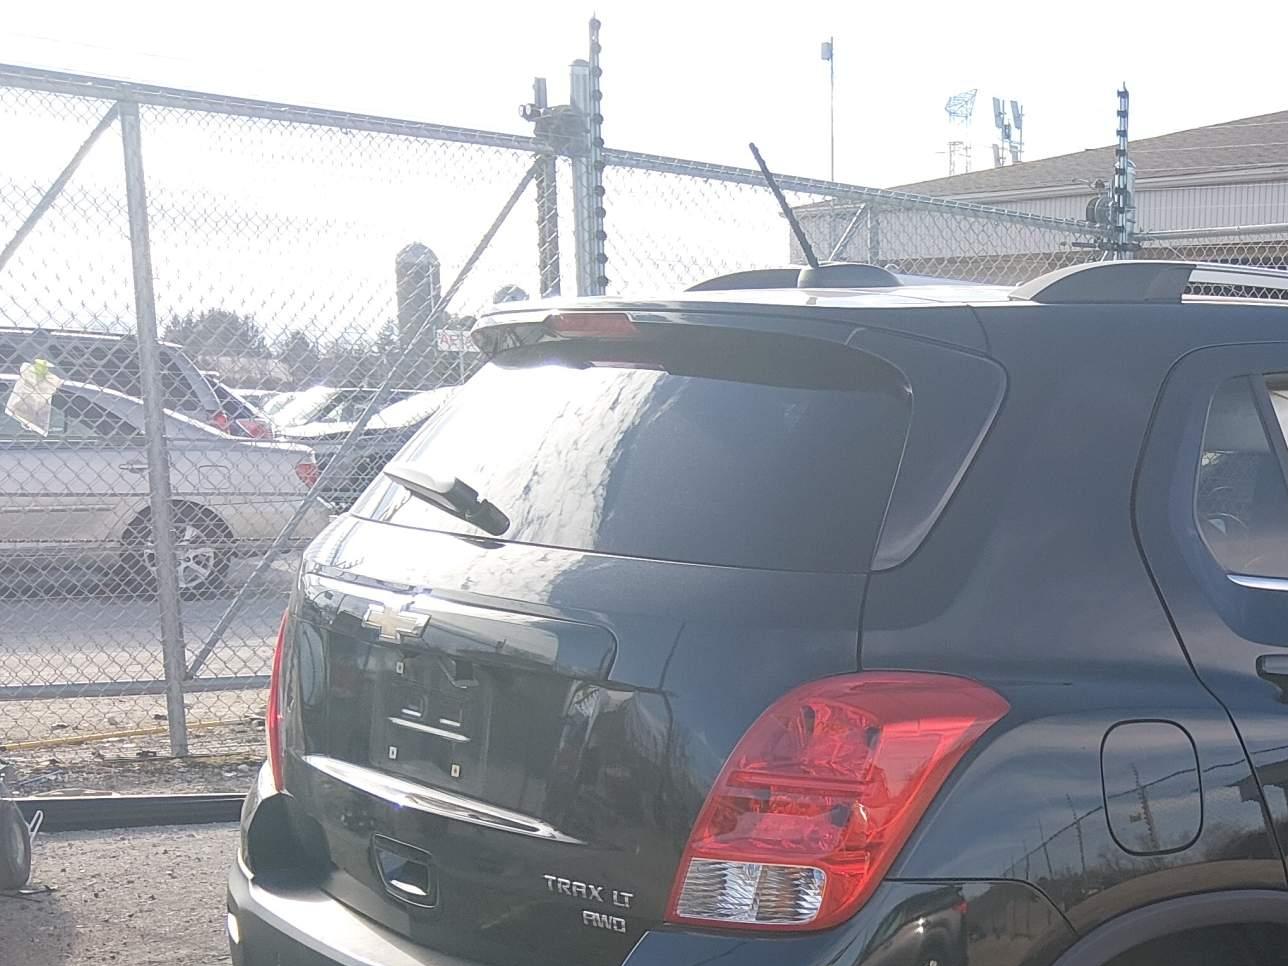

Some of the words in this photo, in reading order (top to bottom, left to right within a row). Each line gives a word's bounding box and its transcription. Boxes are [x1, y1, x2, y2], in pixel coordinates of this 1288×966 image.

[543, 874, 604, 902] TRAX
[612, 890, 634, 908] LT
[582, 910, 626, 933] AWD
